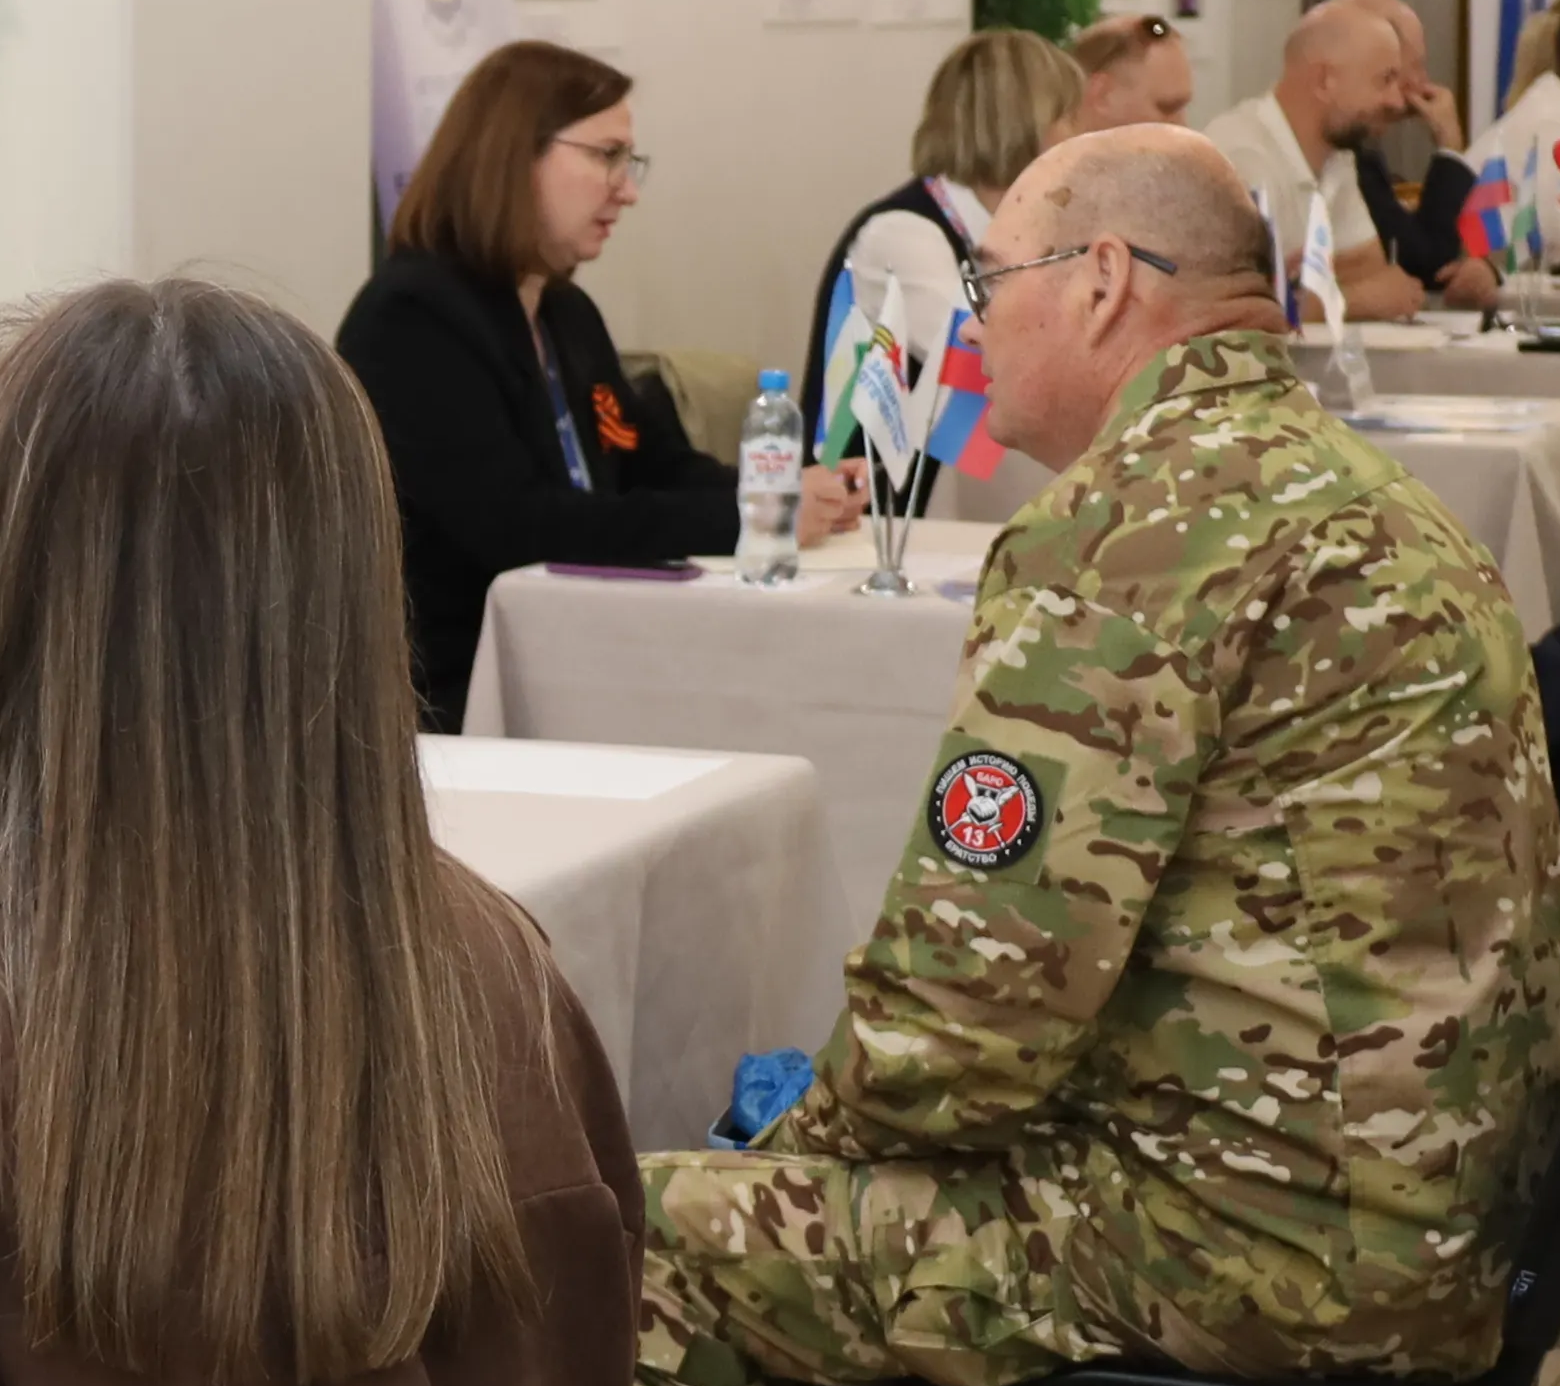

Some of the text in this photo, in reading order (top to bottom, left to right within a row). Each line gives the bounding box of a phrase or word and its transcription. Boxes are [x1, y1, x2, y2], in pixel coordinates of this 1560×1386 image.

[935, 758, 967, 795] ПИШЕМ
[968, 754, 1019, 776] ИСТОРИЮ
[963, 825, 986, 847] 13
[944, 840, 998, 864] БРАТСТВО
